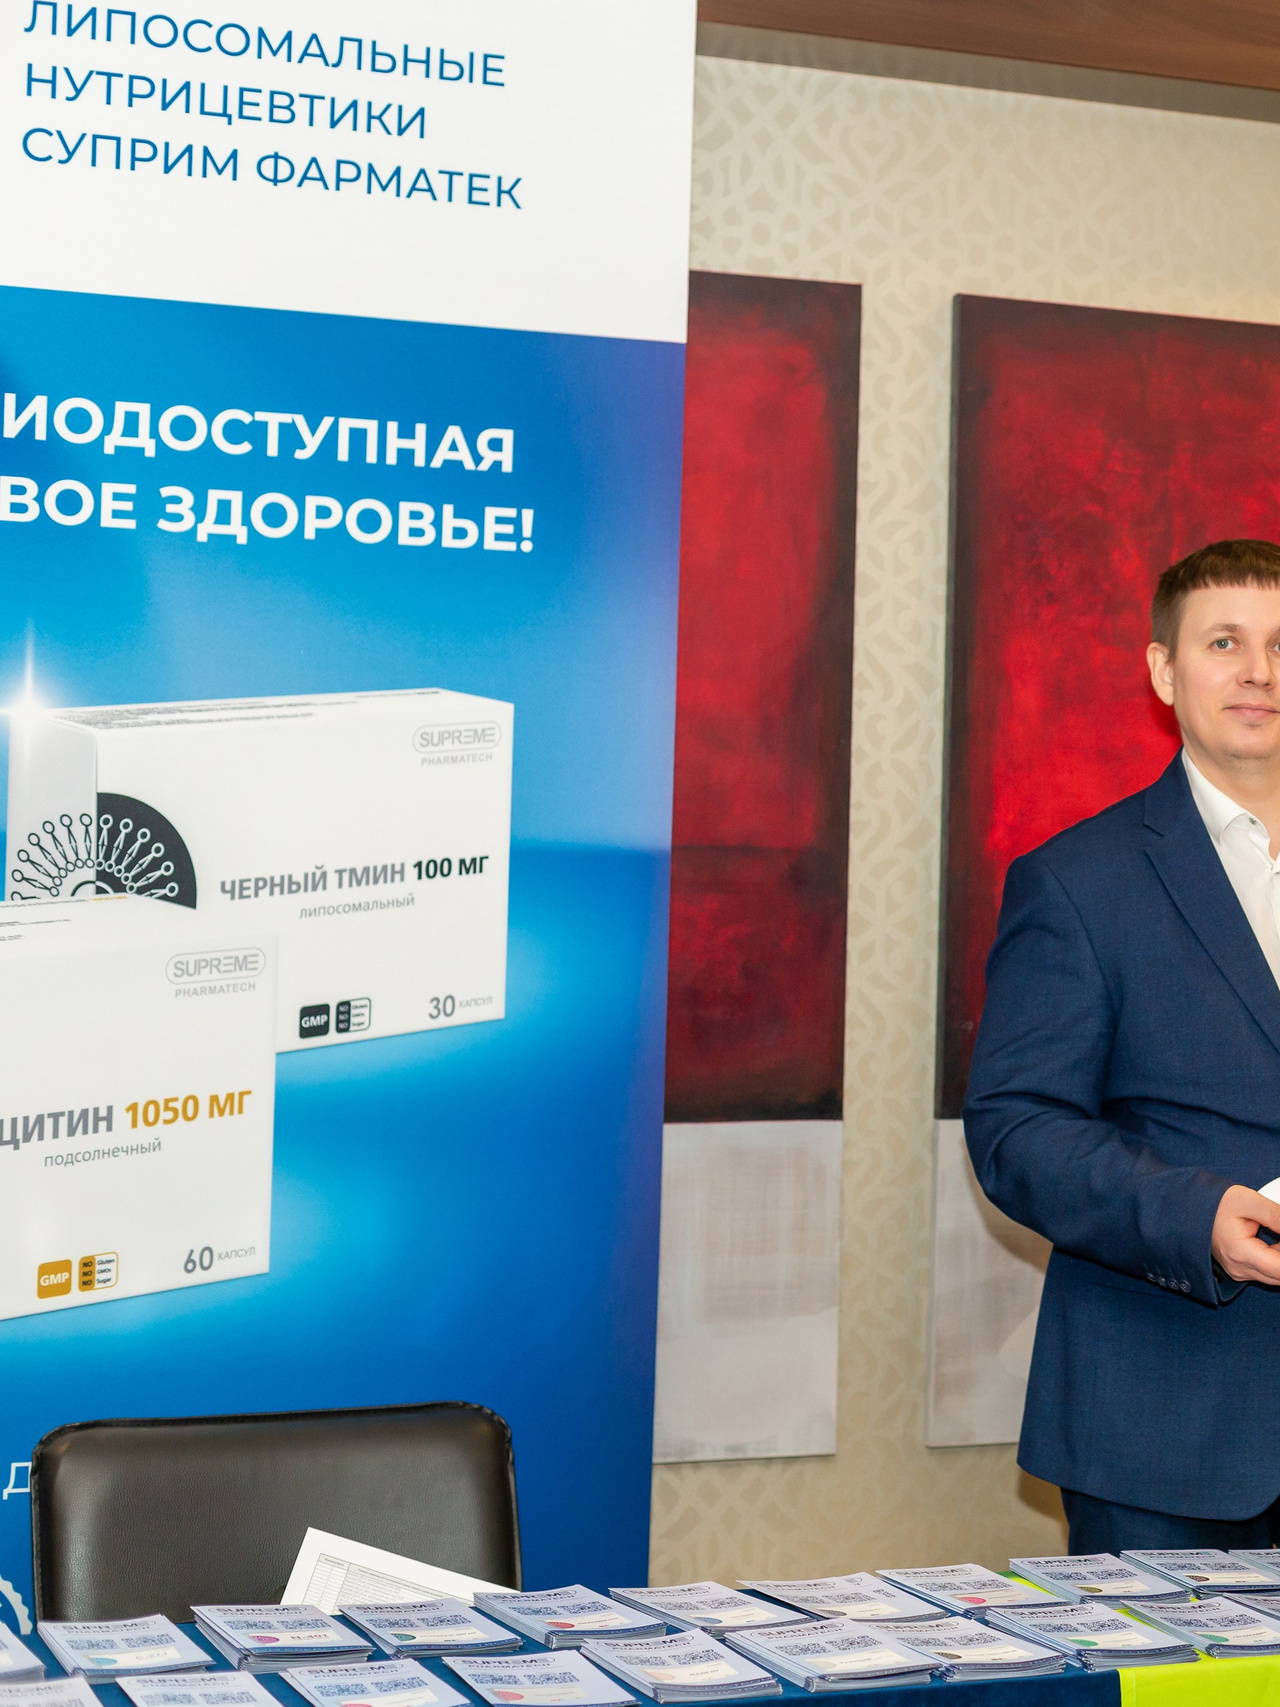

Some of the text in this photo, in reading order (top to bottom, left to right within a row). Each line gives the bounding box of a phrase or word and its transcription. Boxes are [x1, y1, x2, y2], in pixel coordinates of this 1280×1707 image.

[23, 0, 507, 88] ЛИПОСОМАЛЬНЫЕ
[25, 62, 428, 140] НУТРИЦЕВТИКИ
[21, 127, 523, 210] СУПРИМ ФАРМАТЕК
[2, 392, 515, 473] ИОДОСТУПНАЯ
[0, 475, 535, 553] ВОЕ ЗДОРОВЬЕ!
[418, 726, 497, 750] SUPREME
[420, 752, 494, 768] PHARMATECH
[219, 855, 490, 901] ЧЕРНЫЙ ТМИН 100 МГ
[299, 894, 416, 920] липосомальный
[172, 953, 260, 978] SUPREME
[174, 983, 256, 999] PHARMATECH
[428, 995, 493, 1020] 30 КАПСУЛ
[301, 1014, 328, 1028] GMP
[0, 1090, 253, 1151] ЦИТИН 1050 МГ
[44, 1137, 163, 1167] подсолнечный
[82, 1260, 93, 1268] NO
[183, 1246, 256, 1274] 60 КАПСУЛ
[39, 1271, 70, 1287] GMP
[82, 1279, 93, 1287] NO
